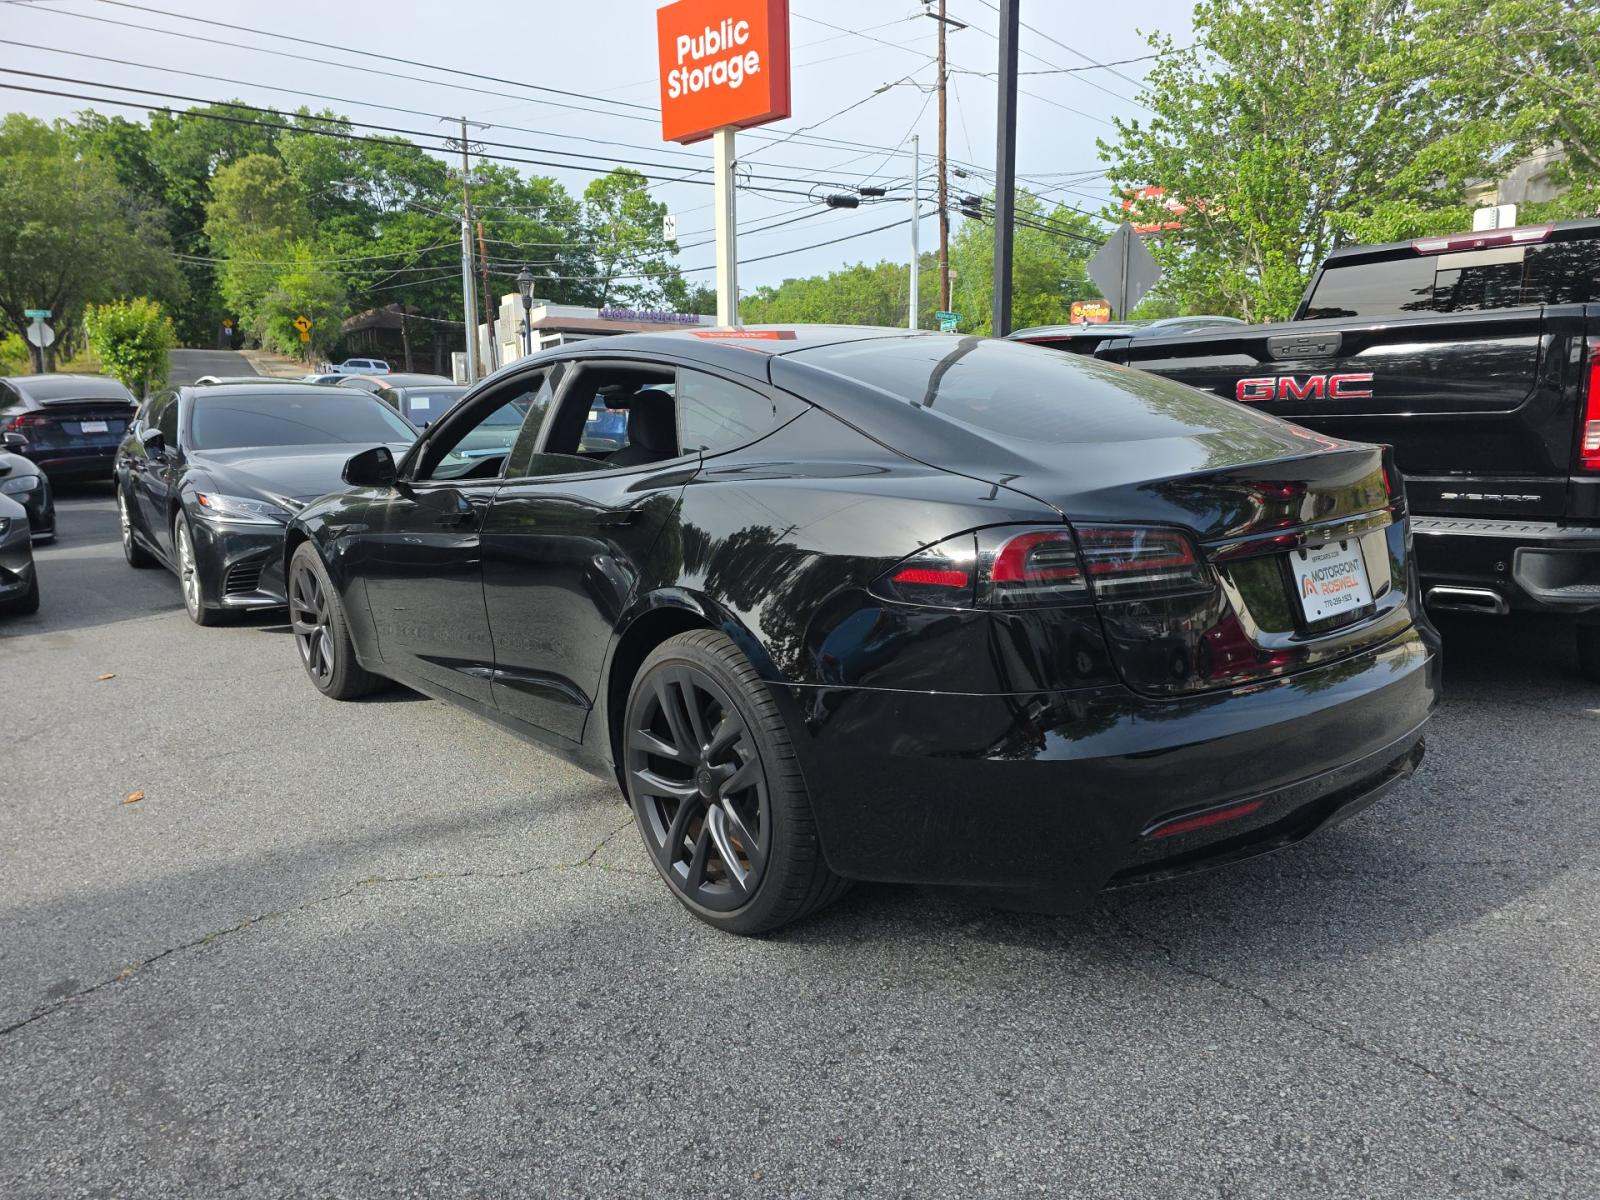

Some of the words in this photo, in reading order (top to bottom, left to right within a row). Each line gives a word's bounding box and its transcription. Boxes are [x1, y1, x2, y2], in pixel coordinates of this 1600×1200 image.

[676, 17, 749, 66] Public
[667, 50, 759, 99] Storage
[1235, 372, 1374, 401] GMC
[1310, 558, 1359, 583] MOTORPOINT
[1320, 575, 1359, 595] ROSWELL
